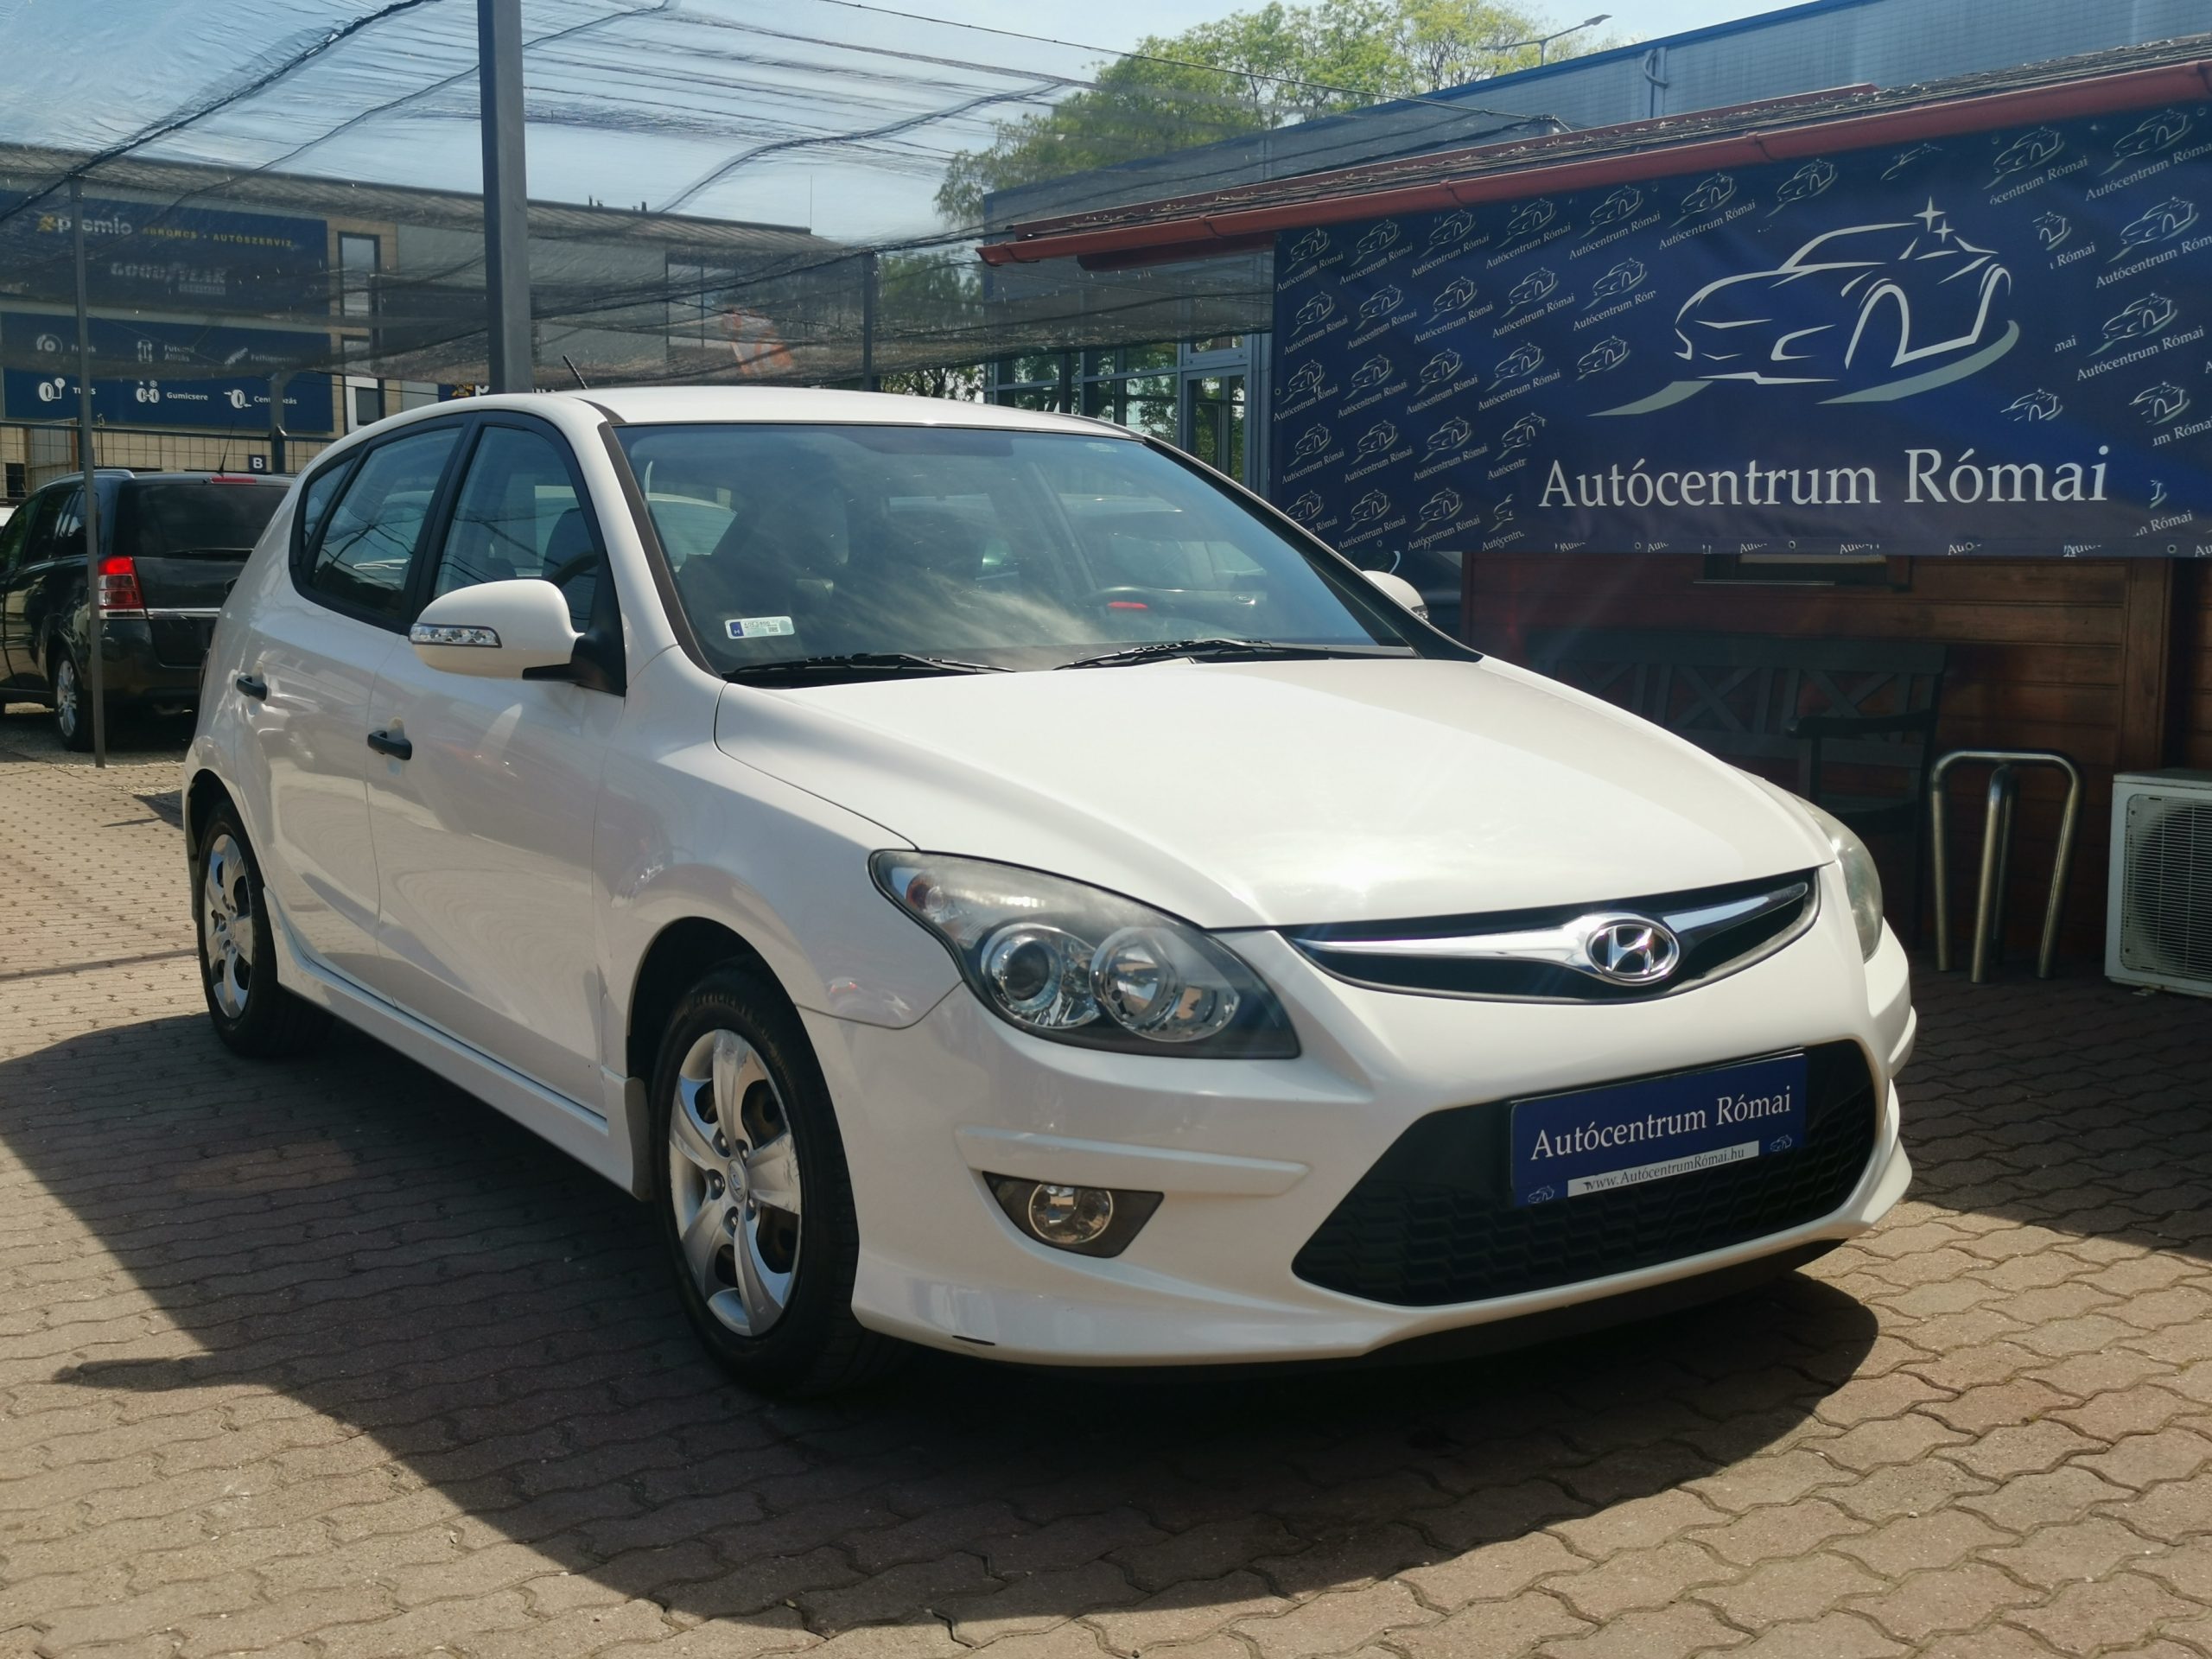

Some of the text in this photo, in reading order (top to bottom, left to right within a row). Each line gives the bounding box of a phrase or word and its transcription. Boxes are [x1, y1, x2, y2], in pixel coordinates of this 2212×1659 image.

[2047, 156, 2089, 181] Római
[2086, 160, 2170, 201] Autócentrum
[58, 216, 132, 235] pemio
[1569, 211, 1661, 260] Autócentrum Római
[1659, 199, 1756, 250] Autócentrum Római
[1338, 245, 1414, 285] Autócentrum Római
[1411, 235, 1490, 278] Autócentrum Római
[1485, 222, 1572, 270] Autócentrum Római
[1276, 253, 1344, 292] Autócentrum Római
[2095, 249, 2178, 289] Autócentrum
[1284, 315, 1349, 356] Autócentrum Római
[1348, 309, 1418, 350] Autócentrum Római
[1414, 302, 1493, 344] Autócentrum Római
[1492, 293, 1575, 338] Autócentrum Római
[1573, 301, 1632, 332] Autócentrum
[2077, 325, 2204, 381] Autócentrum Római
[167, 392, 208, 401] Gumicsere
[1338, 379, 1408, 418] Autócentrum Római
[1406, 374, 1478, 415] Autócentrum Római
[1478, 369, 1561, 411] Autócentrum Római
[2173, 416, 2212, 440] Róma
[253, 457, 264, 468] B
[1281, 448, 1344, 484] Autócentrum Római
[1344, 446, 1414, 483] Autócentrum Római
[1413, 443, 1488, 481] Autócentrum Római
[1538, 445, 2108, 507] Autócentrum Római
[1338, 518, 1407, 551] Autócentrum Római
[1408, 516, 1481, 551] Autócentrum Római
[2150, 509, 2193, 532] Római
[1530, 1085, 1791, 1160] Autócentrum Római
